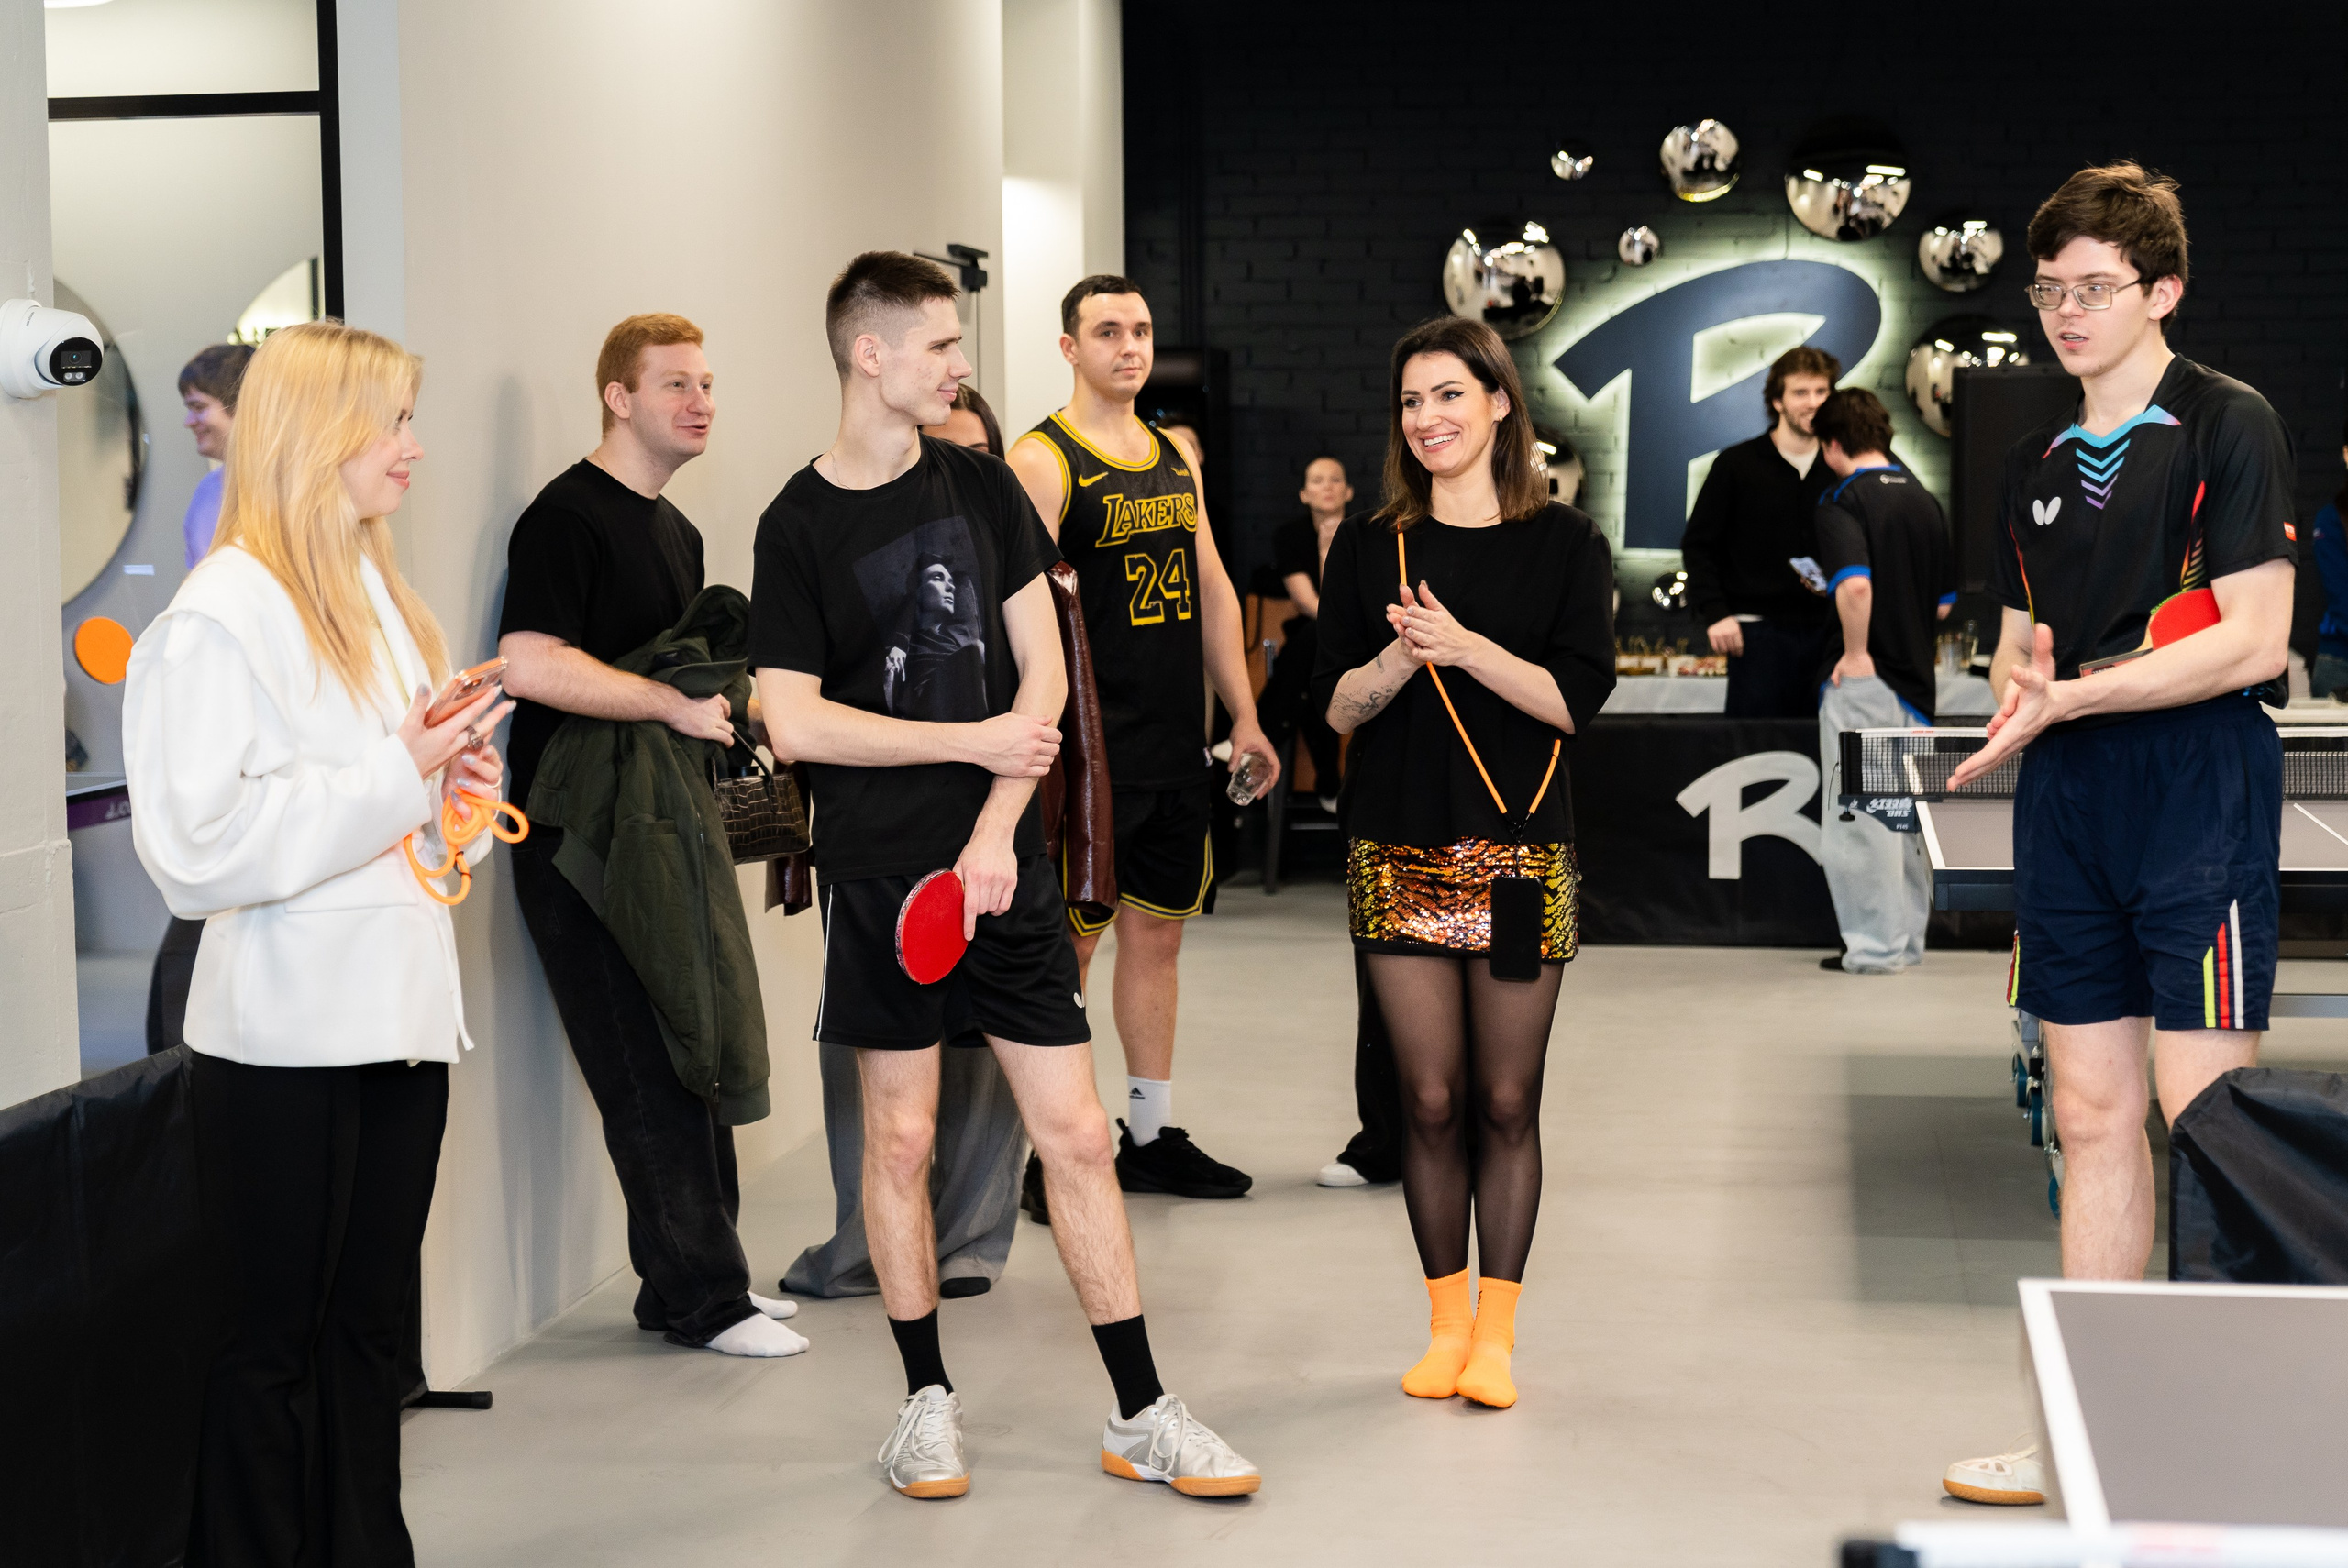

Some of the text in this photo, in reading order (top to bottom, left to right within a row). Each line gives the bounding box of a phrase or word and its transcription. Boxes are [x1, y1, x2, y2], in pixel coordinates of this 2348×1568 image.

[1095, 492, 1198, 548] LAKERS
[1124, 548, 1191, 626] 24
[1676, 751, 1823, 879] R
